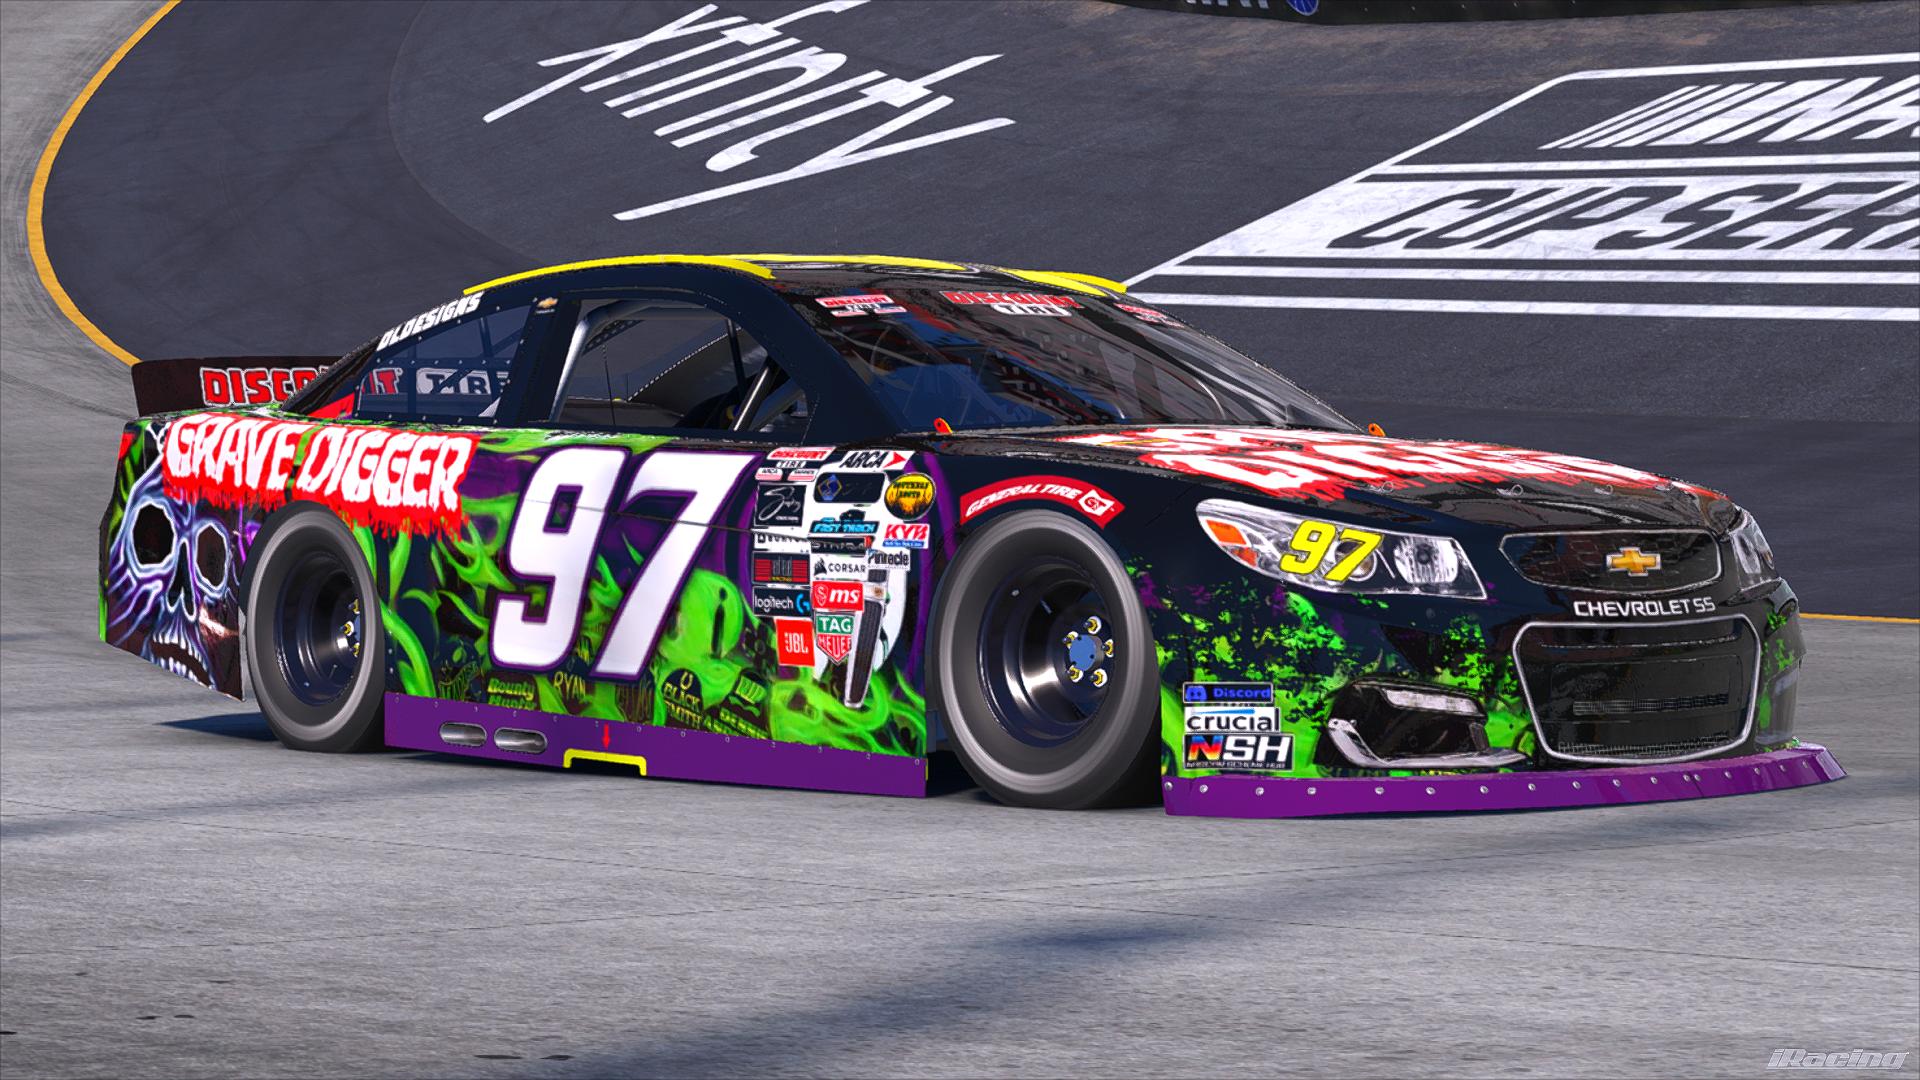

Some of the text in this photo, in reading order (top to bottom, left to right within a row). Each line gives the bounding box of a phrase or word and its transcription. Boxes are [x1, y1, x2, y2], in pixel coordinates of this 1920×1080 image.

[482, 0, 1016, 222] xfinity
[1327, 185, 1688, 250] CUP
[163, 411, 473, 512] GRAVE DIGGER
[838, 450, 890, 469] ARCA
[965, 483, 1042, 518] GENERAL
[1039, 483, 1083, 500] TIRE
[884, 523, 929, 540] KYB
[491, 447, 757, 677] 97
[1279, 520, 1384, 582] 97
[754, 593, 794, 612] logitech
[1573, 596, 1717, 618] CHEVROLET SS
[819, 617, 852, 633] TAG
[784, 632, 809, 654] JBL
[1212, 687, 1272, 698] Discord
[1186, 707, 1280, 731] crucial
[1187, 735, 1291, 762] NSH
